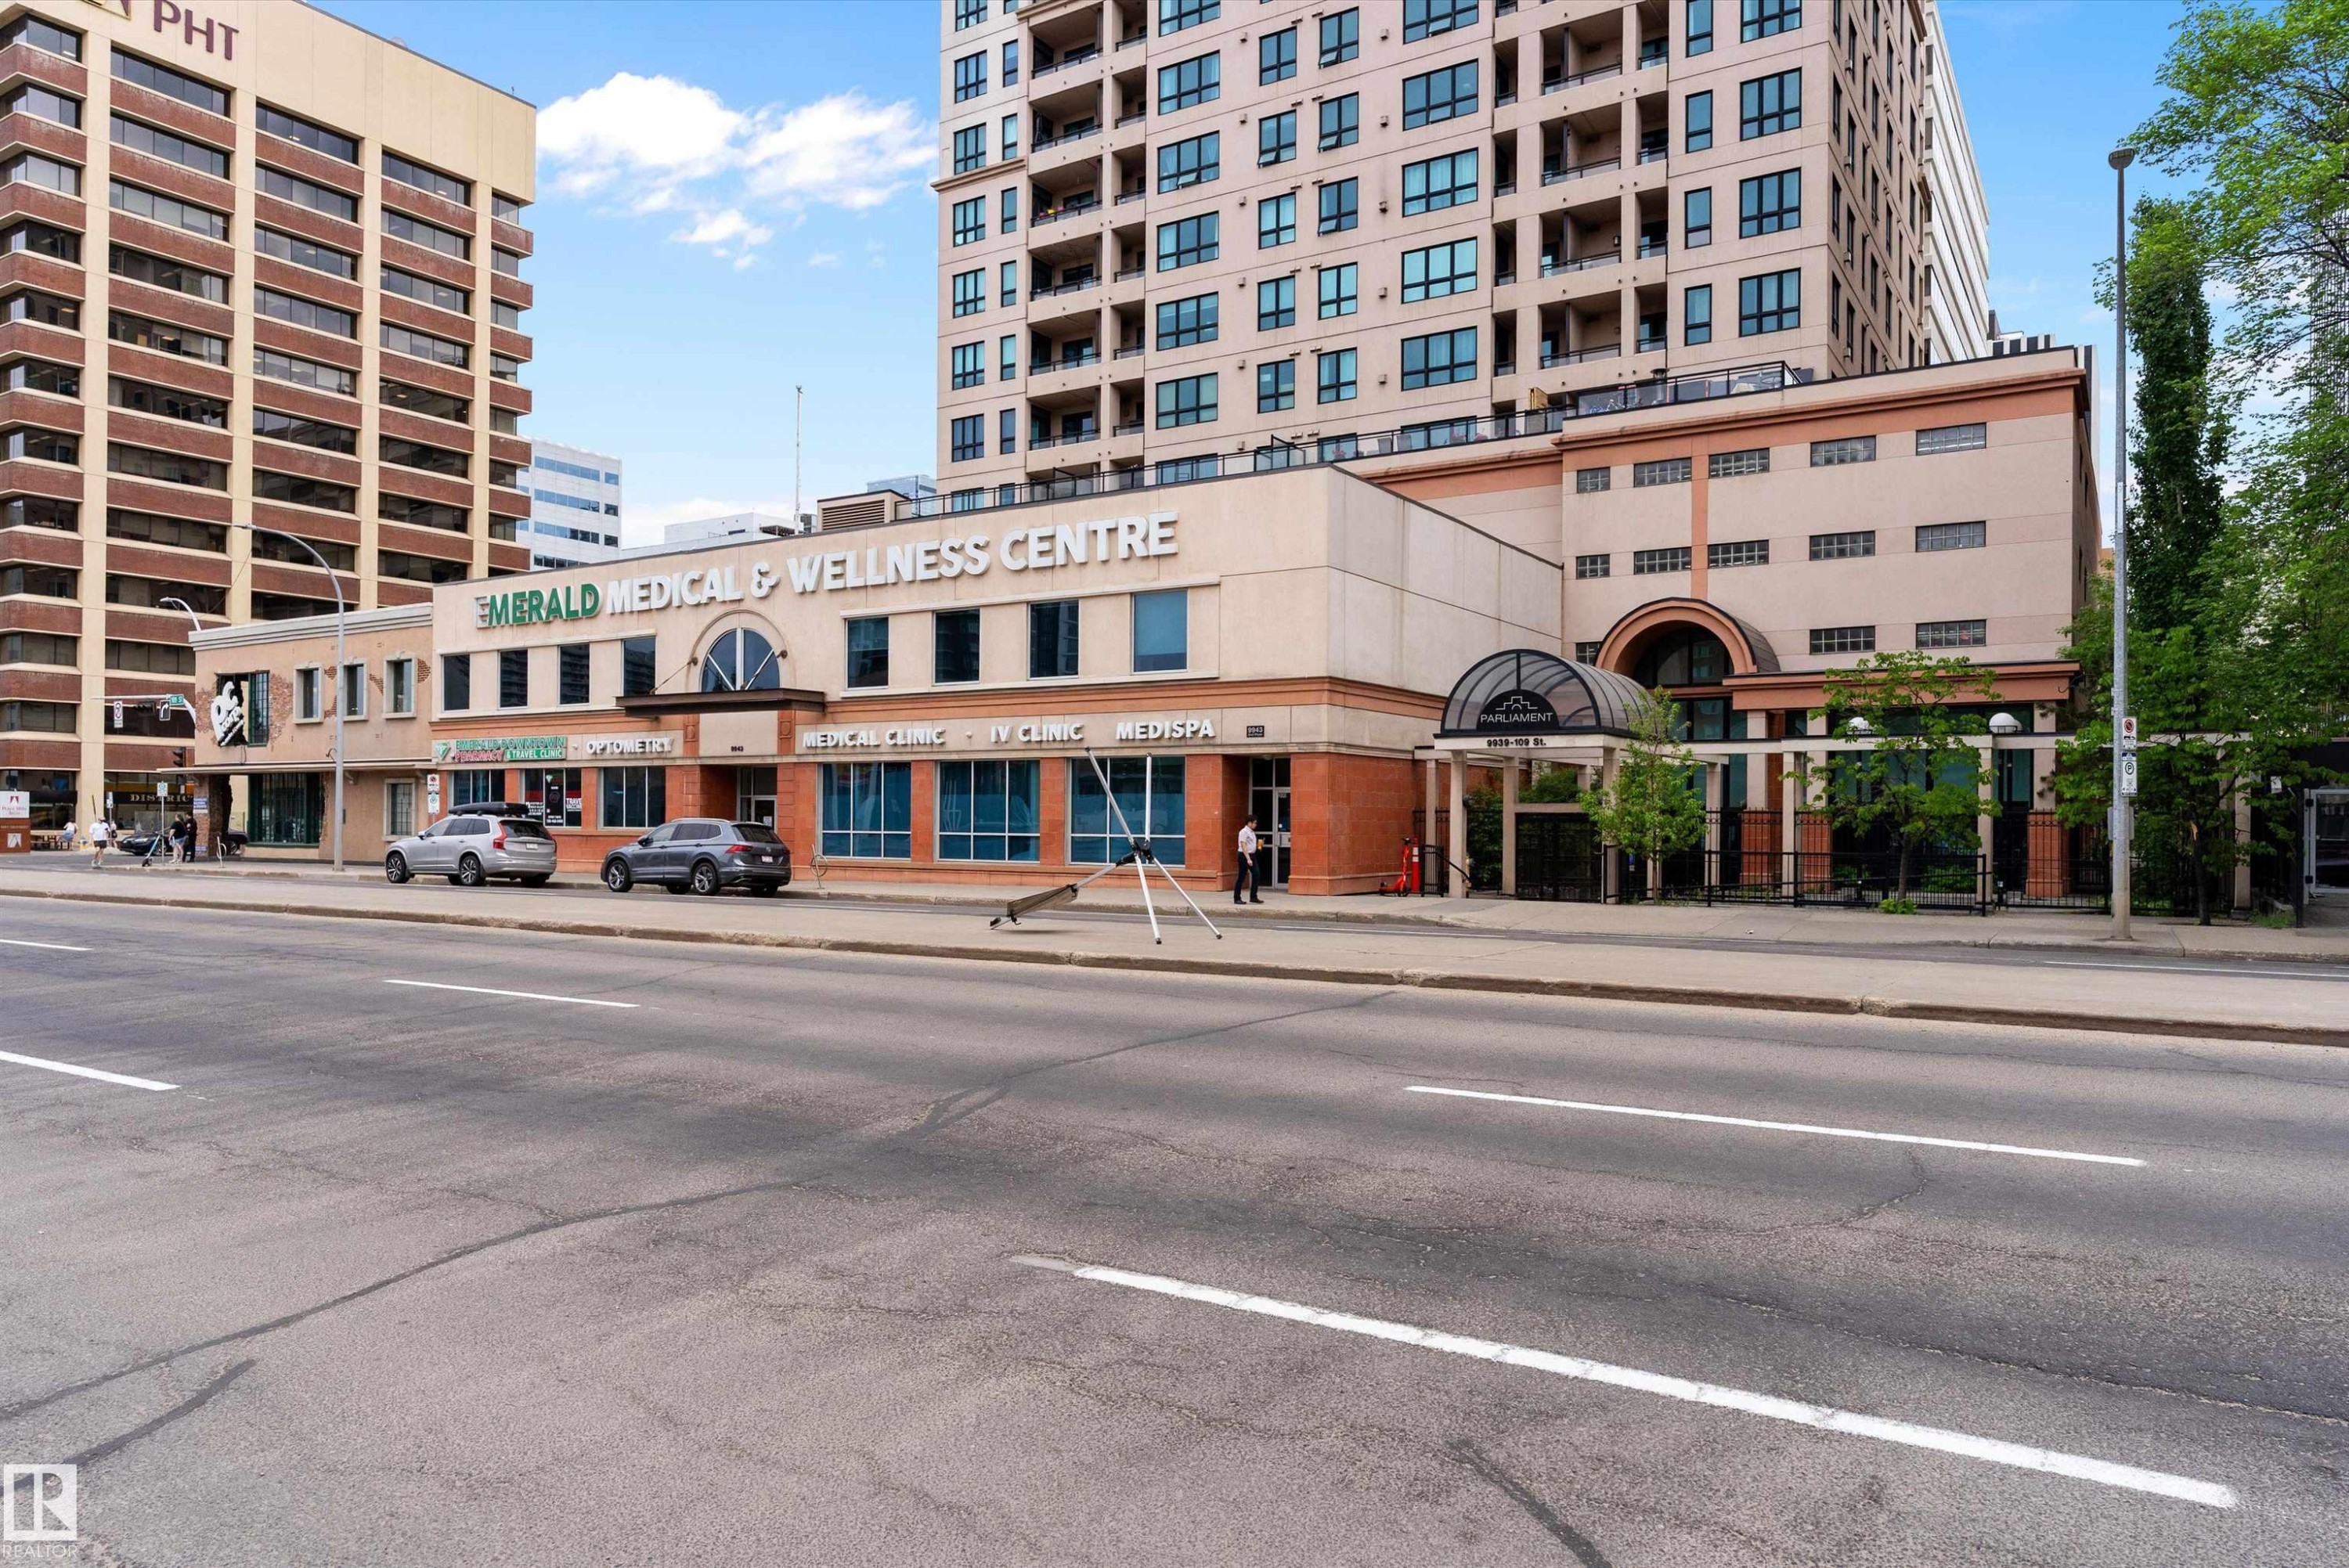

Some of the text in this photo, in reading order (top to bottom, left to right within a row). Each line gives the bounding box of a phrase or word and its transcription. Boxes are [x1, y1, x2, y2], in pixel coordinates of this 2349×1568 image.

[153, 0, 239, 60] PHT
[474, 511, 1179, 629] EMERALD MEDICAL & WELLNESS CENTRE
[1481, 712, 1553, 723] PARLIAMENT
[803, 719, 1218, 748] MEDICAL CLINIC IV CLINIC MEDISPA
[456, 737, 565, 750] EMERALD DOWNTOWN
[586, 737, 674, 754] OPTOMETRY
[1487, 737, 1546, 747] 9939-109 St.
[455, 749, 504, 762] PHARMACY
[512, 749, 538, 759] TRAVEL
[540, 749, 563, 759] CLINIC
